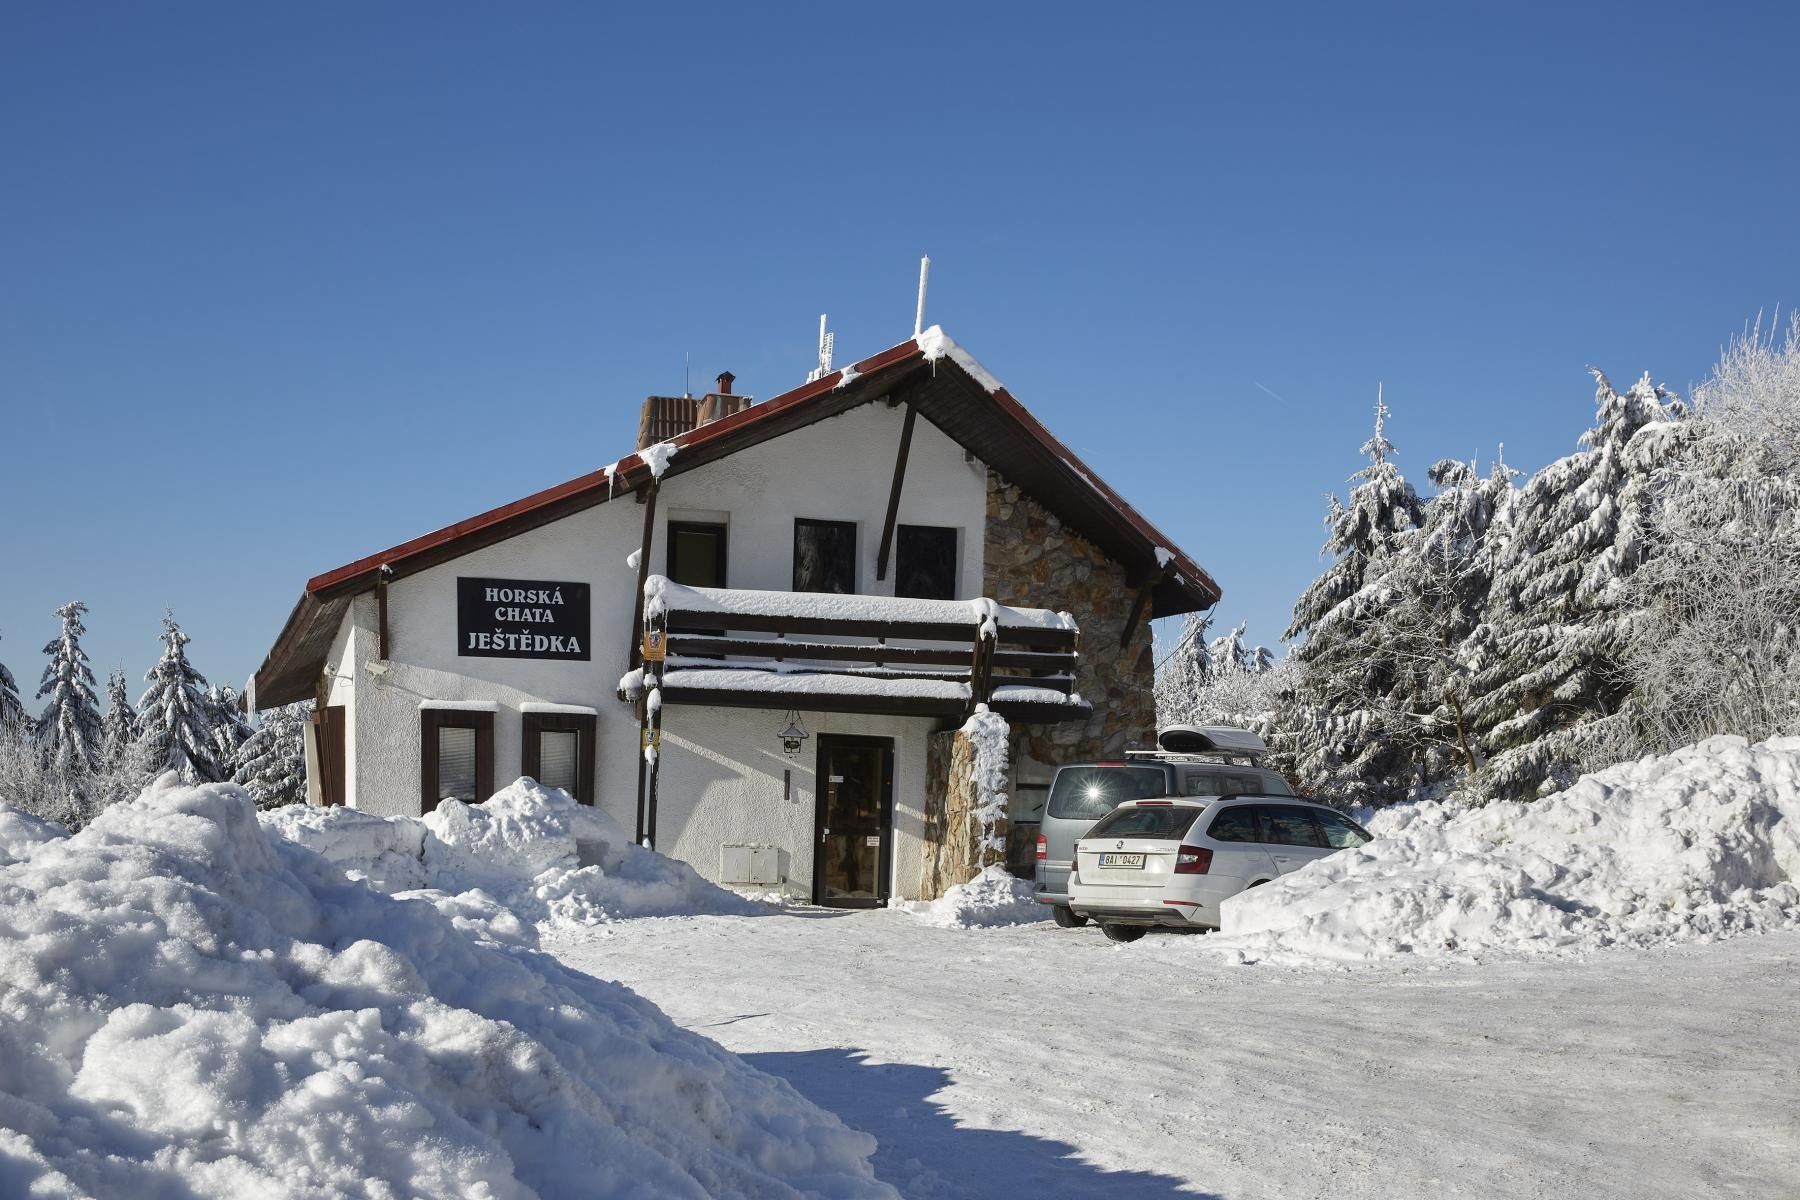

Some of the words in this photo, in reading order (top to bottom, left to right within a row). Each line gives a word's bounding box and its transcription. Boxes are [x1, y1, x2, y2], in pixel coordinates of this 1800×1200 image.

[485, 587, 564, 605] HORSKÁ
[495, 607, 555, 623] CHATA
[468, 628, 581, 653] JEŠTĚDKA
[1122, 855, 1141, 865] 0427
